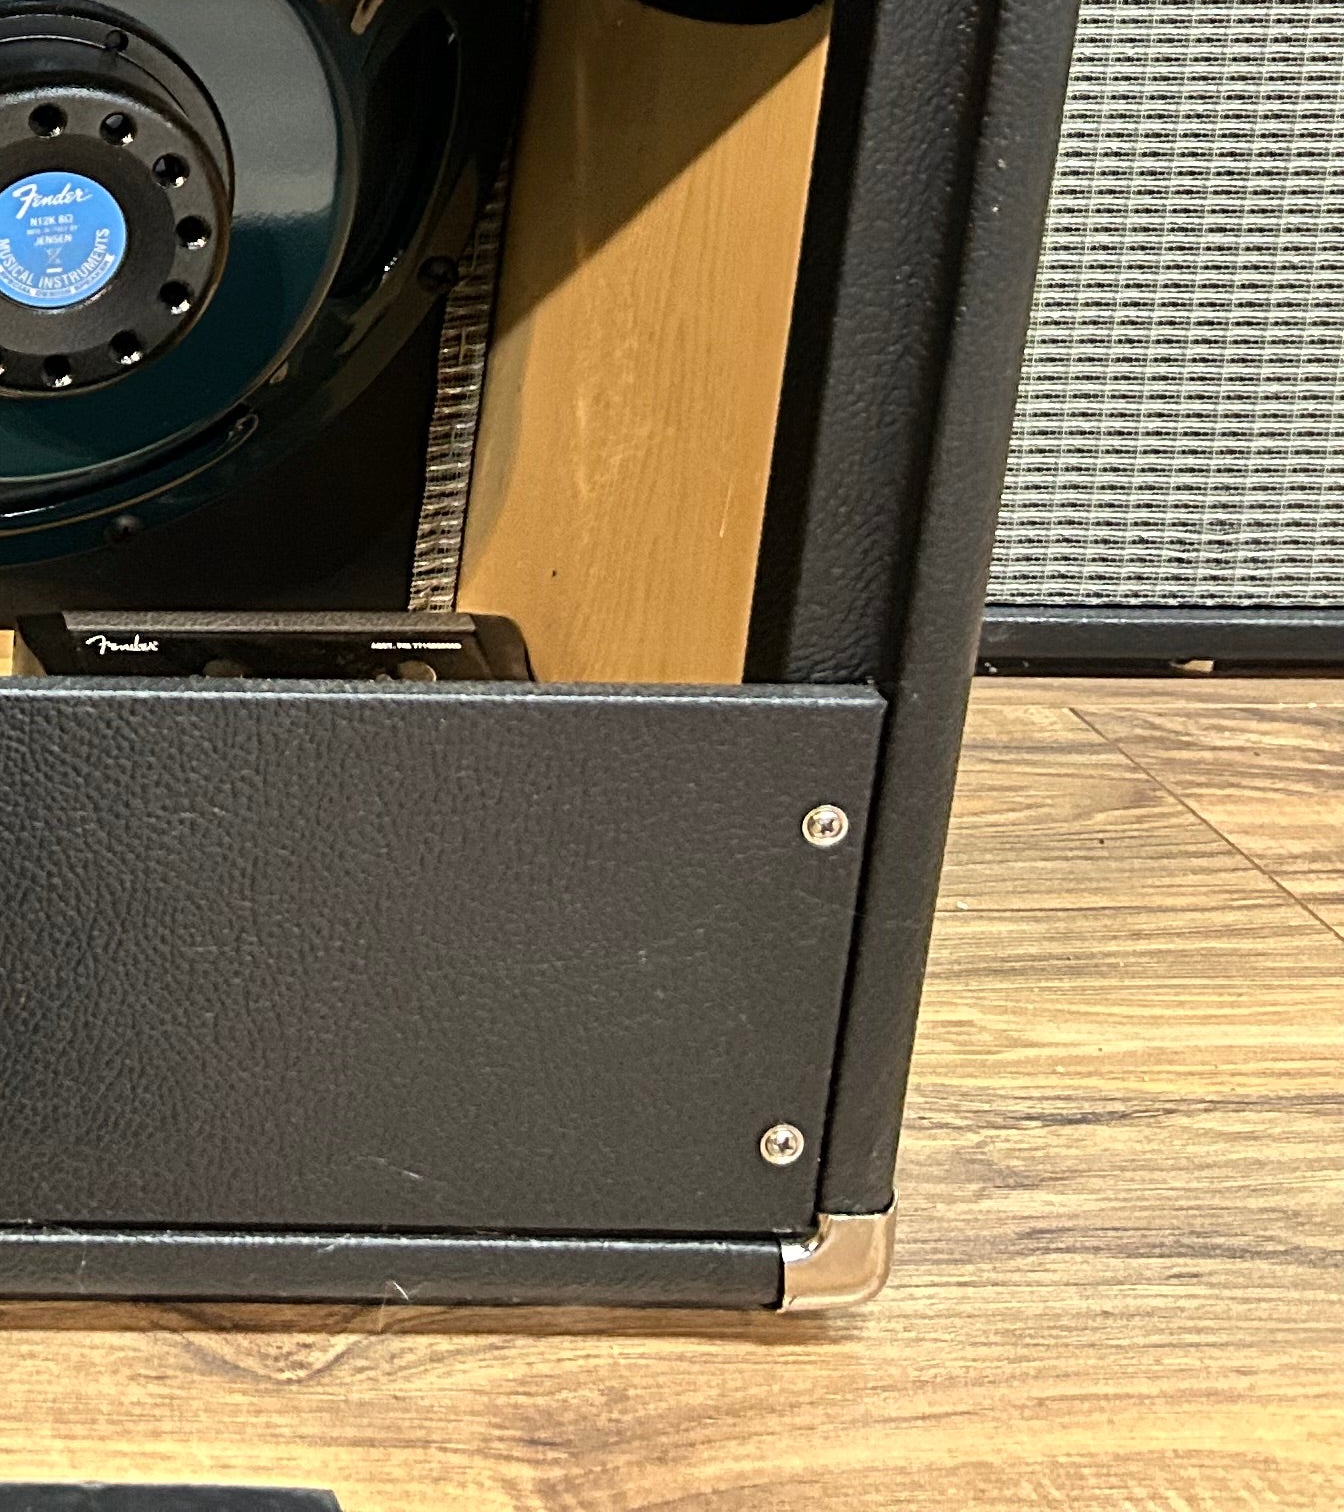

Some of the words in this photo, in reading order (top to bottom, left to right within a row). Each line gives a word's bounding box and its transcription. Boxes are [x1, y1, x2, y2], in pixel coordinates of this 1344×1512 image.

[13, 182, 93, 220] Fender
[38, 228, 110, 288] INSTRUMENTS
[86, 634, 160, 653] Fender
